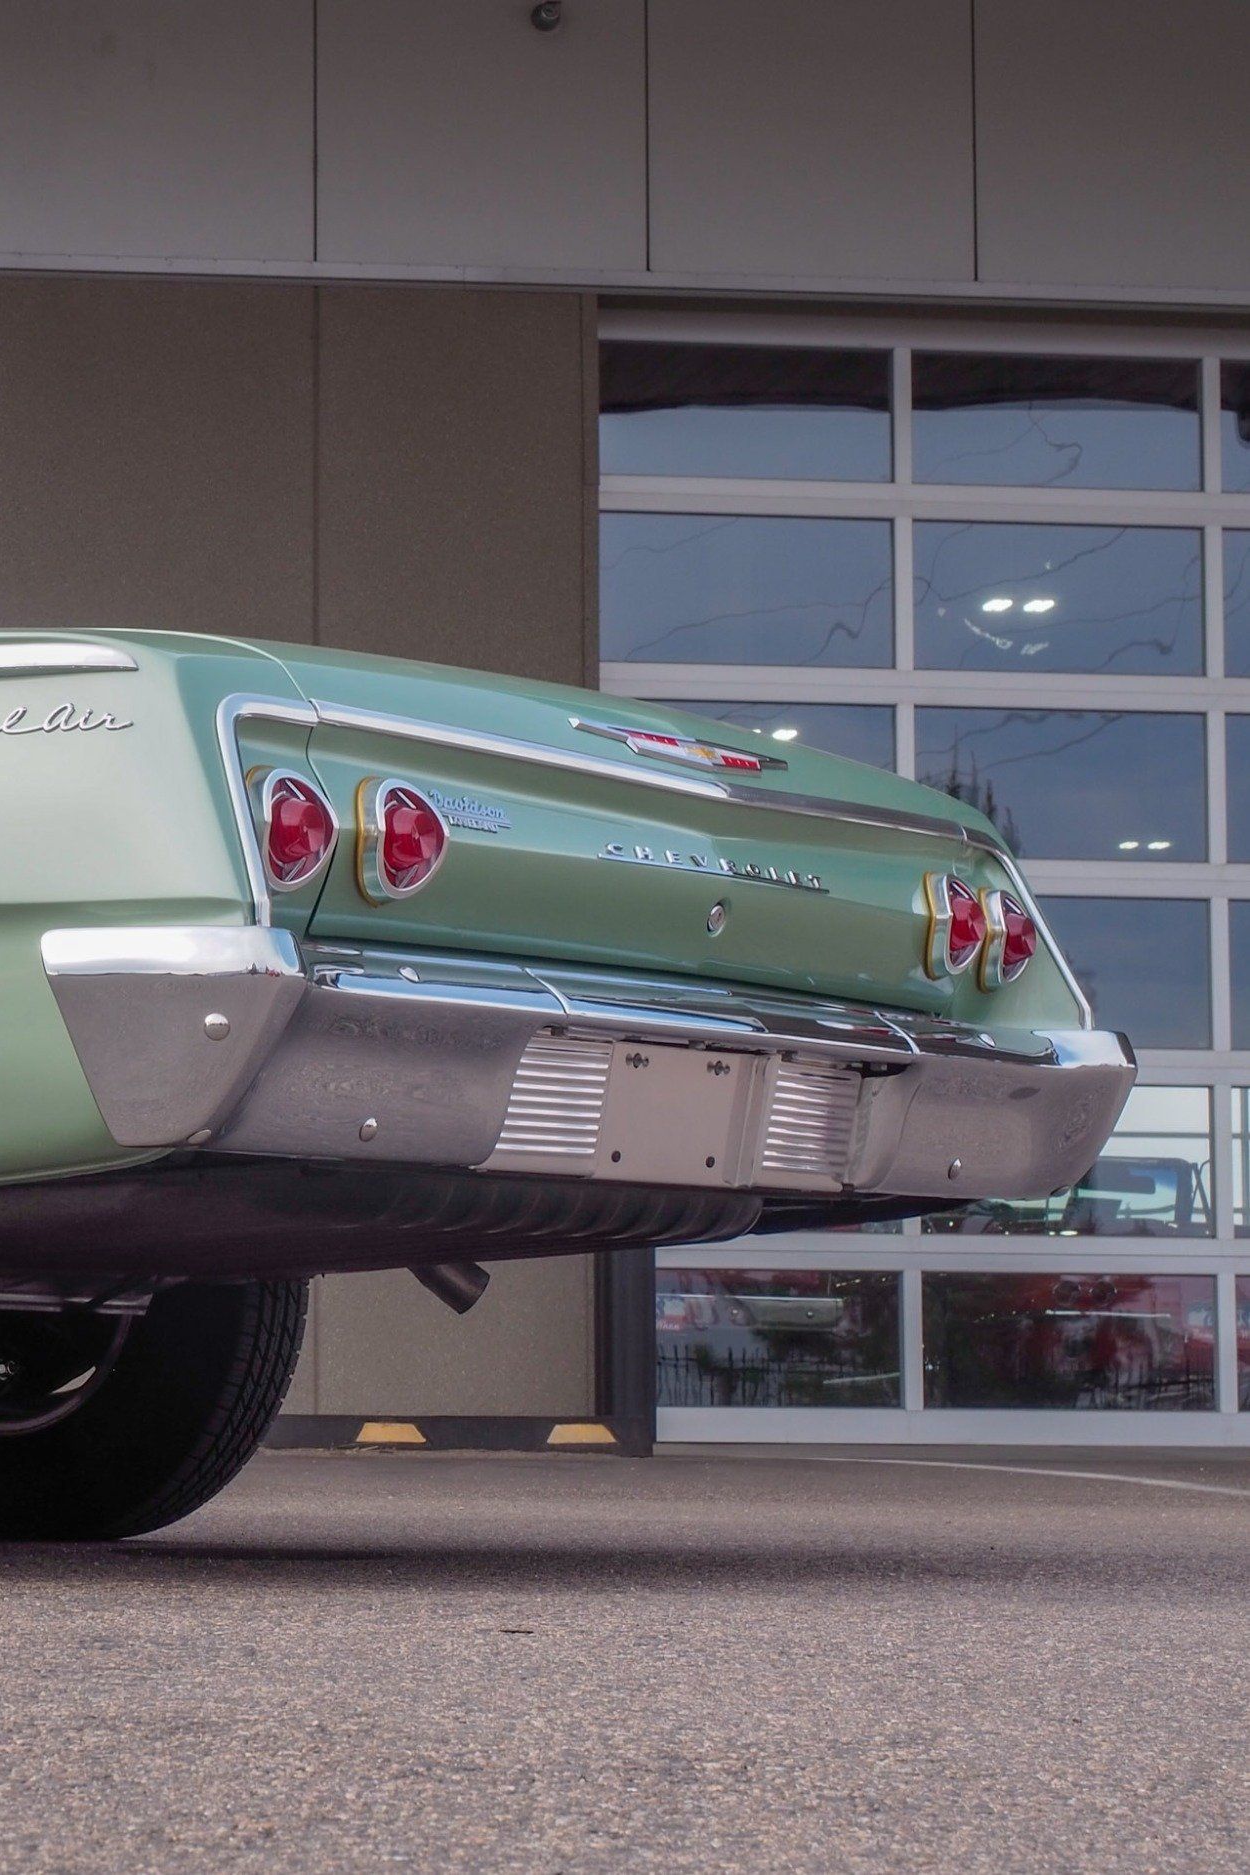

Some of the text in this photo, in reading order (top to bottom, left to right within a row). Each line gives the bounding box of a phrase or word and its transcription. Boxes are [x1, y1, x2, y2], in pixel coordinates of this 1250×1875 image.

[42, 702, 134, 732] Air
[428, 788, 507, 819] Davidson
[604, 842, 824, 889] CHEVROLET
